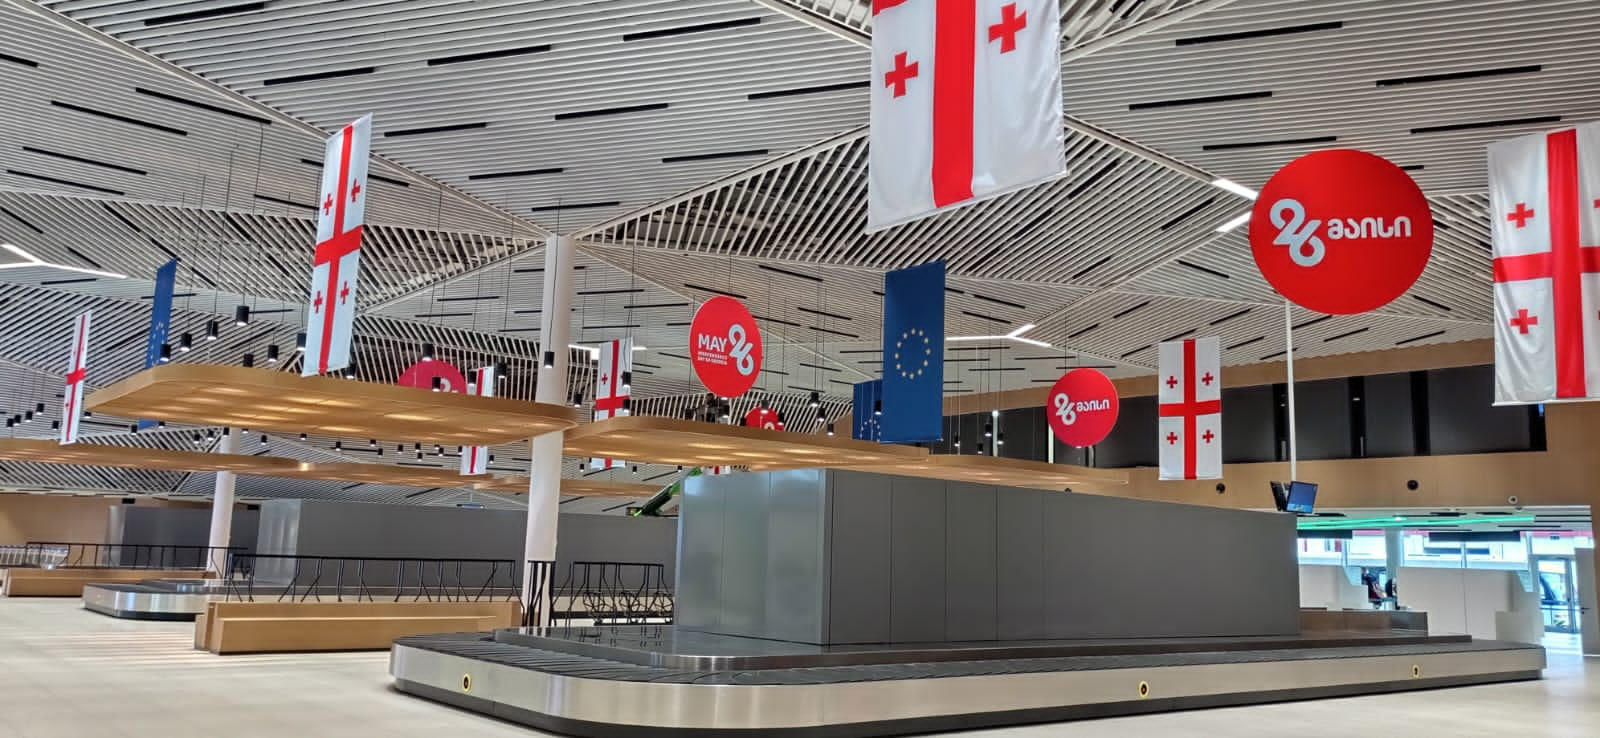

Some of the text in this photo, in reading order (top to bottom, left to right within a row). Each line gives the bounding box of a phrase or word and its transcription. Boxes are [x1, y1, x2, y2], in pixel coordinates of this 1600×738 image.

[1270, 198, 1412, 267] 26 მაისი
[698, 324, 754, 376] MAY 26
[1054, 392, 1110, 426] 26 მაისი
